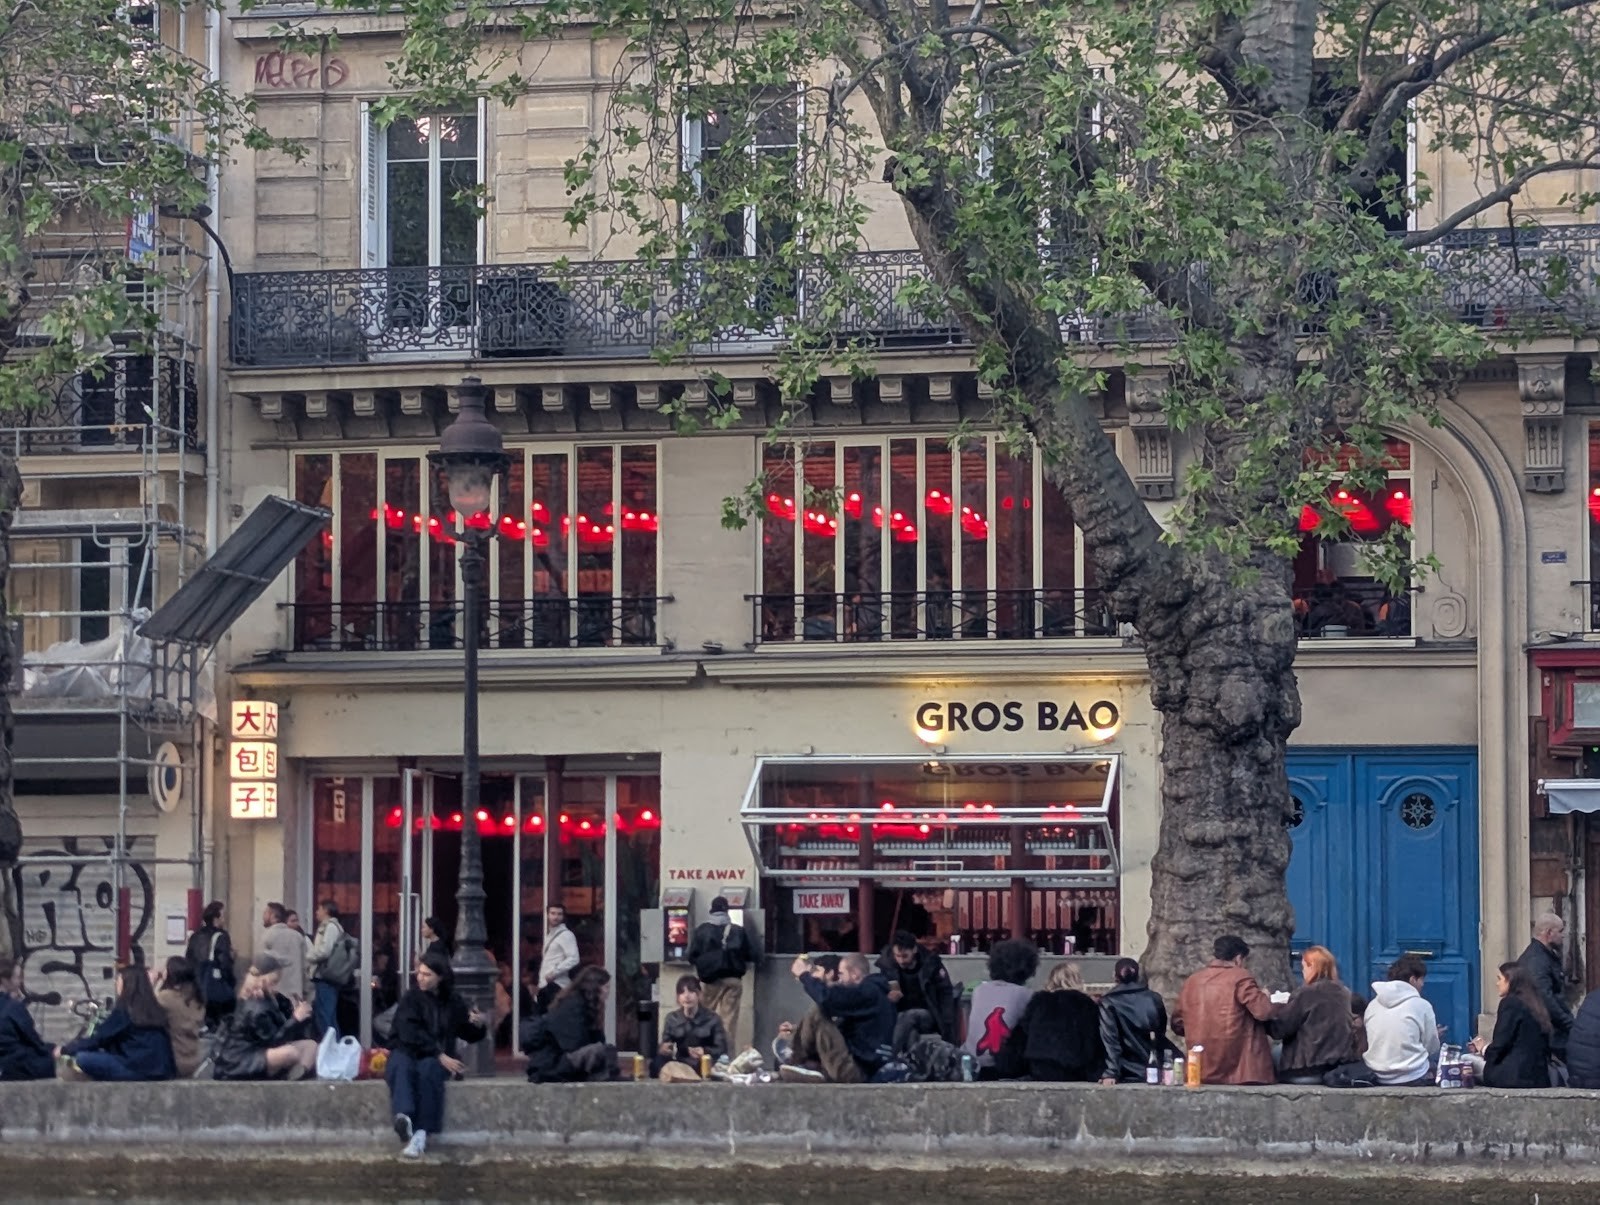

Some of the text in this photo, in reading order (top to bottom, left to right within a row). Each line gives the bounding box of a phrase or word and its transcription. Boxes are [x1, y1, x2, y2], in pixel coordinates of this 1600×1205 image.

[917, 700, 1119, 731] GROS BAO
[236, 705, 261, 812] 大包子
[669, 869, 745, 880] TAKE AWAY
[798, 893, 845, 908] TAKE AWAY
